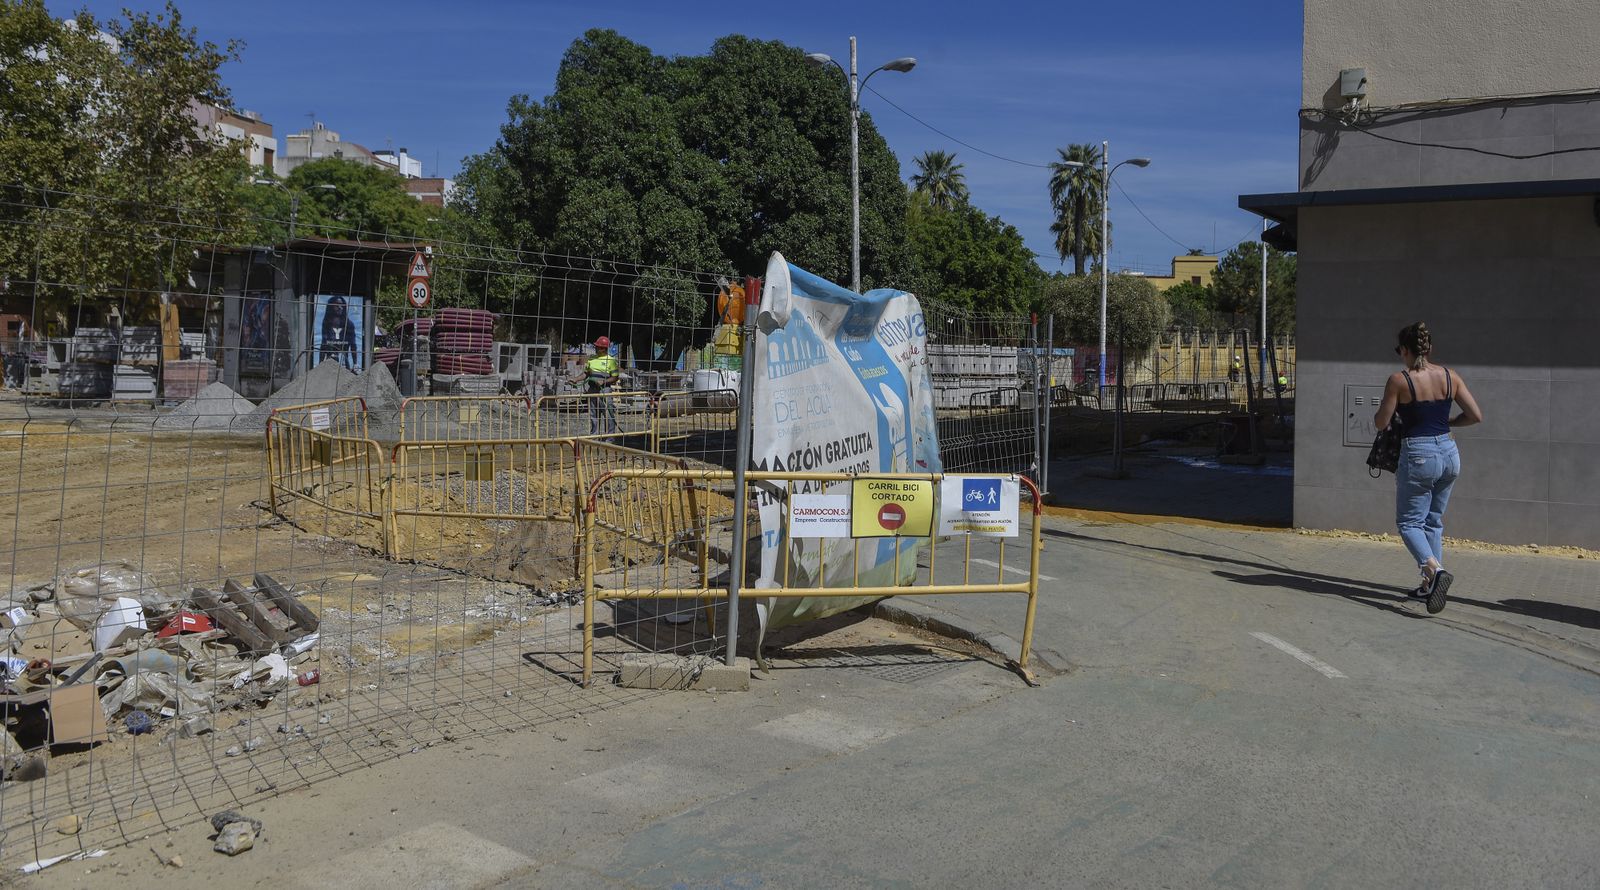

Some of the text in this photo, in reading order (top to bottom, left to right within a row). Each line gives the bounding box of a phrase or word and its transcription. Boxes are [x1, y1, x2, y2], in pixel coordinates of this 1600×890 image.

[413, 288, 426, 298] 30
[774, 400, 802, 423] DEL
[825, 432, 873, 463] GRATUITA
[868, 482, 920, 492] CARRIL BICI
[871, 493, 915, 502] CORTADO
